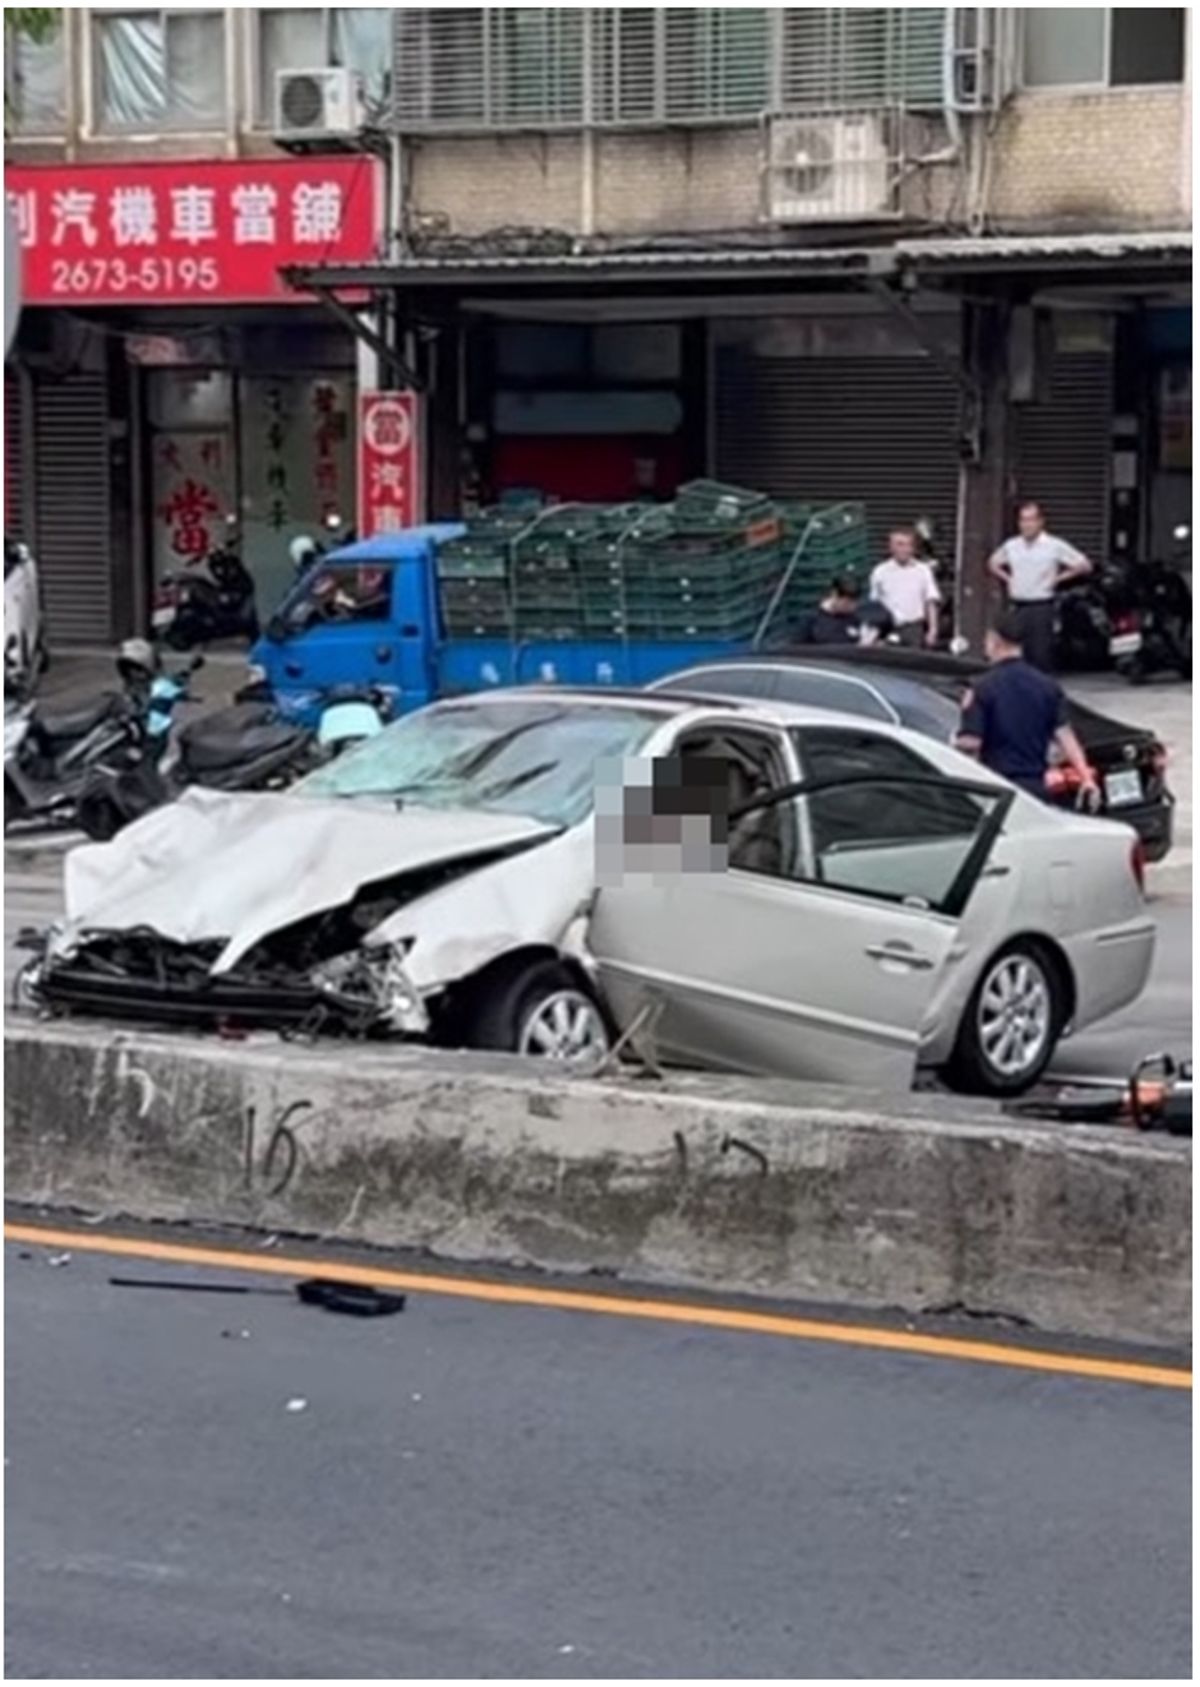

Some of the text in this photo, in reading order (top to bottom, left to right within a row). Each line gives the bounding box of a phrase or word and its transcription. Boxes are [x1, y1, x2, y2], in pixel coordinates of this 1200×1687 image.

[51, 257, 219, 292] 2673-5195
[156, 477, 220, 568] 當
[245, 1100, 314, 1196] 16
